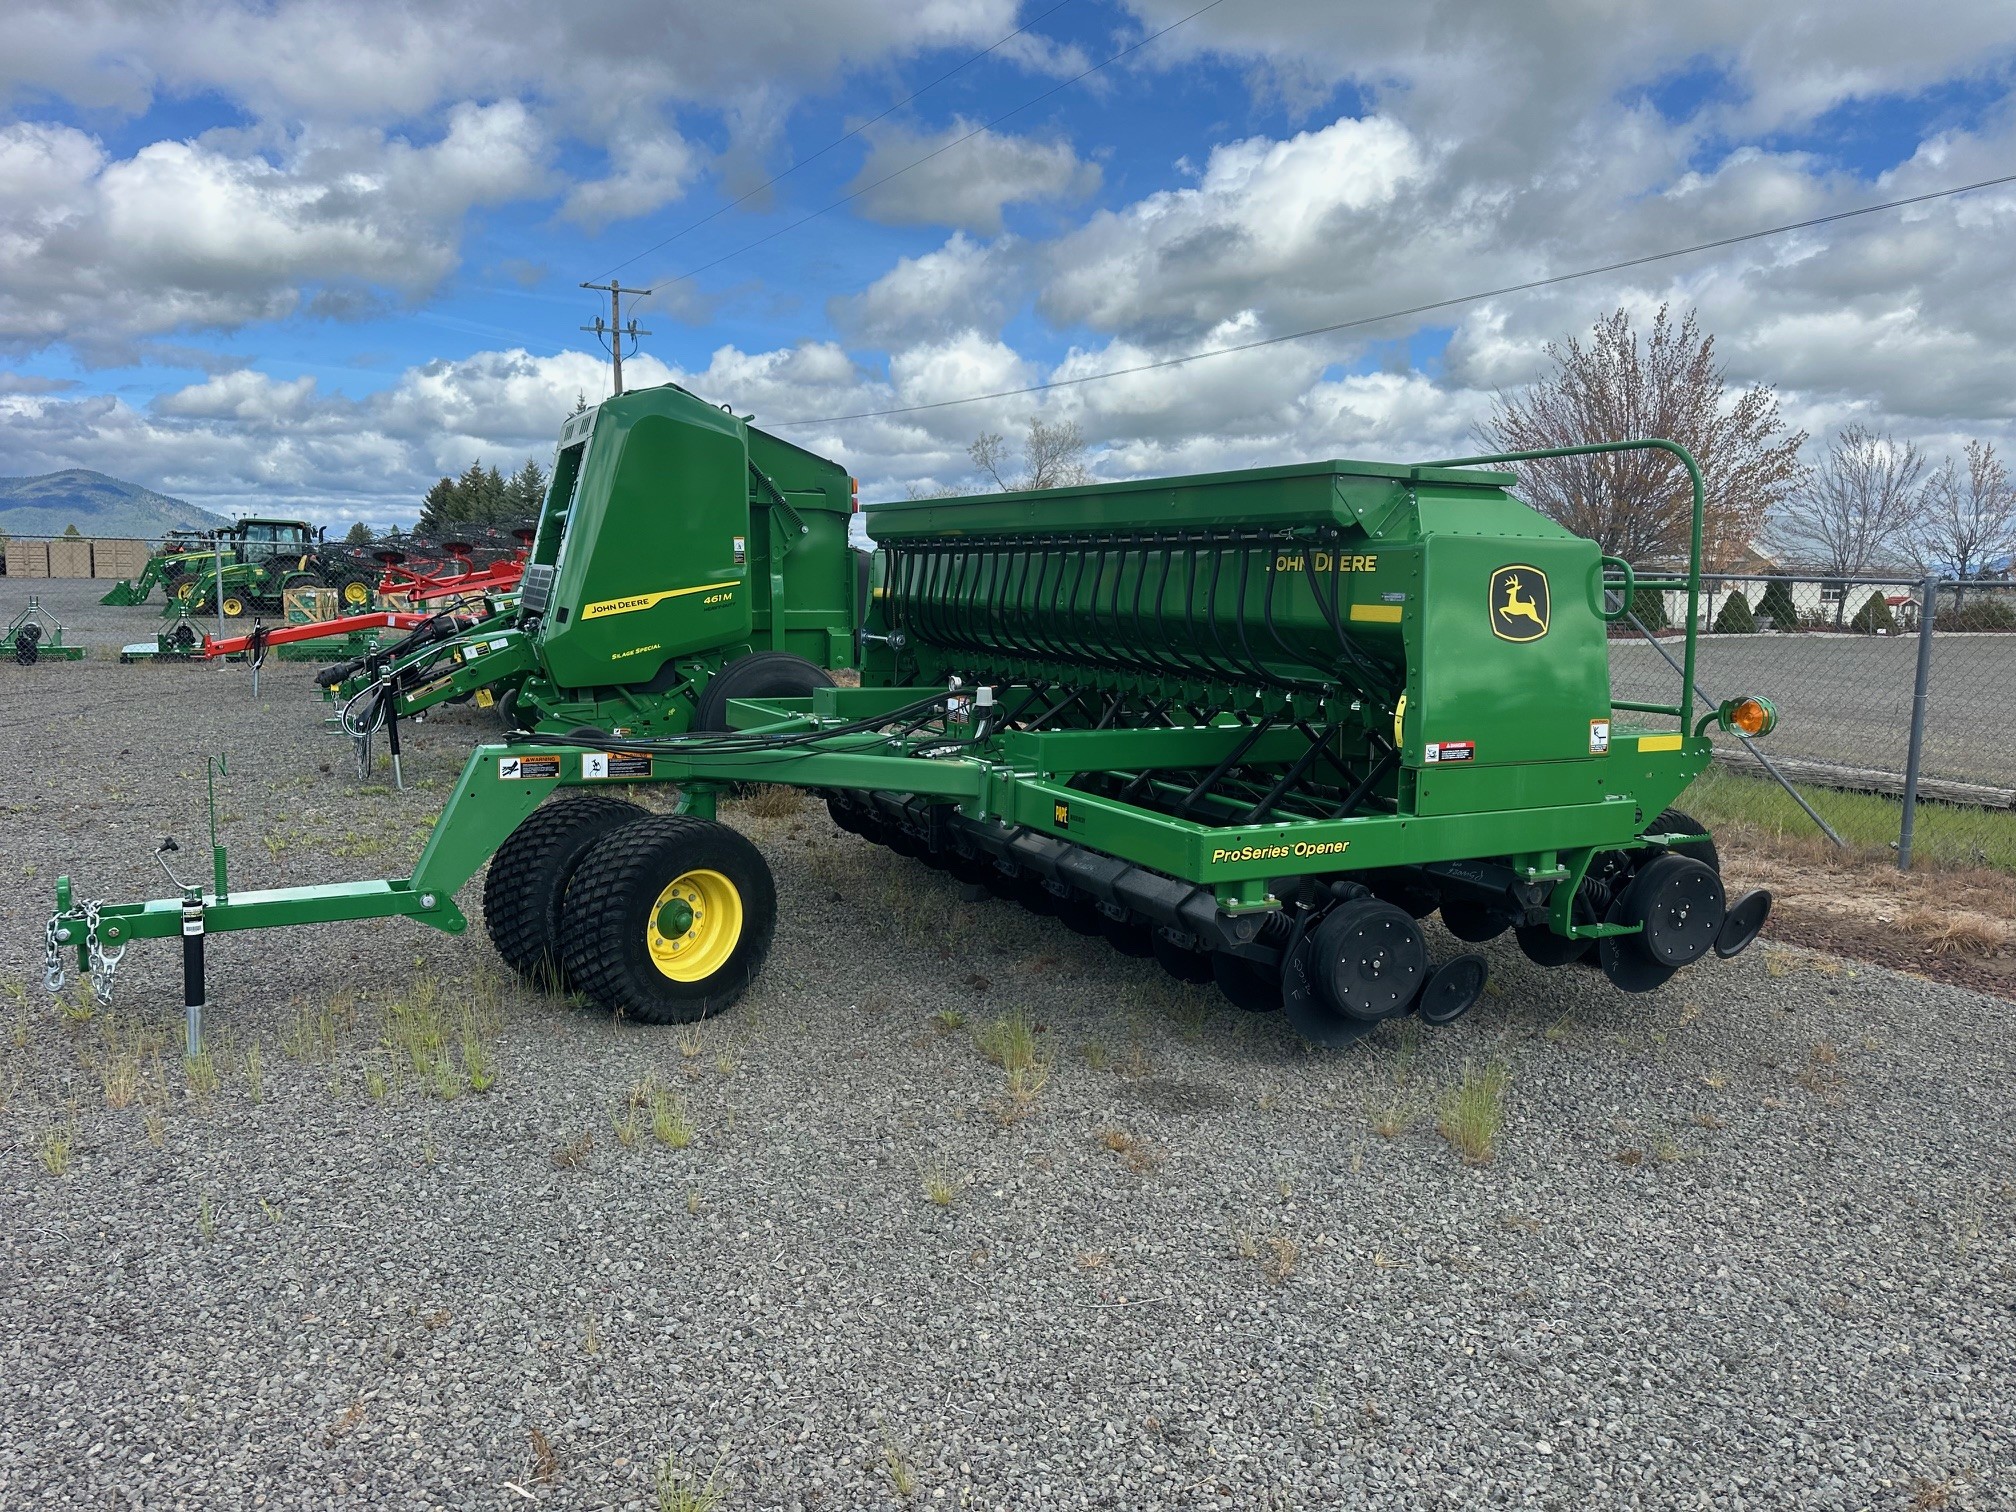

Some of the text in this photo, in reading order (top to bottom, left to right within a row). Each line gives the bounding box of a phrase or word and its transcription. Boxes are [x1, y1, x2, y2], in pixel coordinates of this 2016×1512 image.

[1265, 555, 1311, 572] OH
[591, 598, 650, 614] JOHN DEERE
[703, 592, 733, 604] 461M
[611, 643, 661, 660] SILAGE SPECIAL
[1212, 841, 1350, 864] ProSeries Opener
